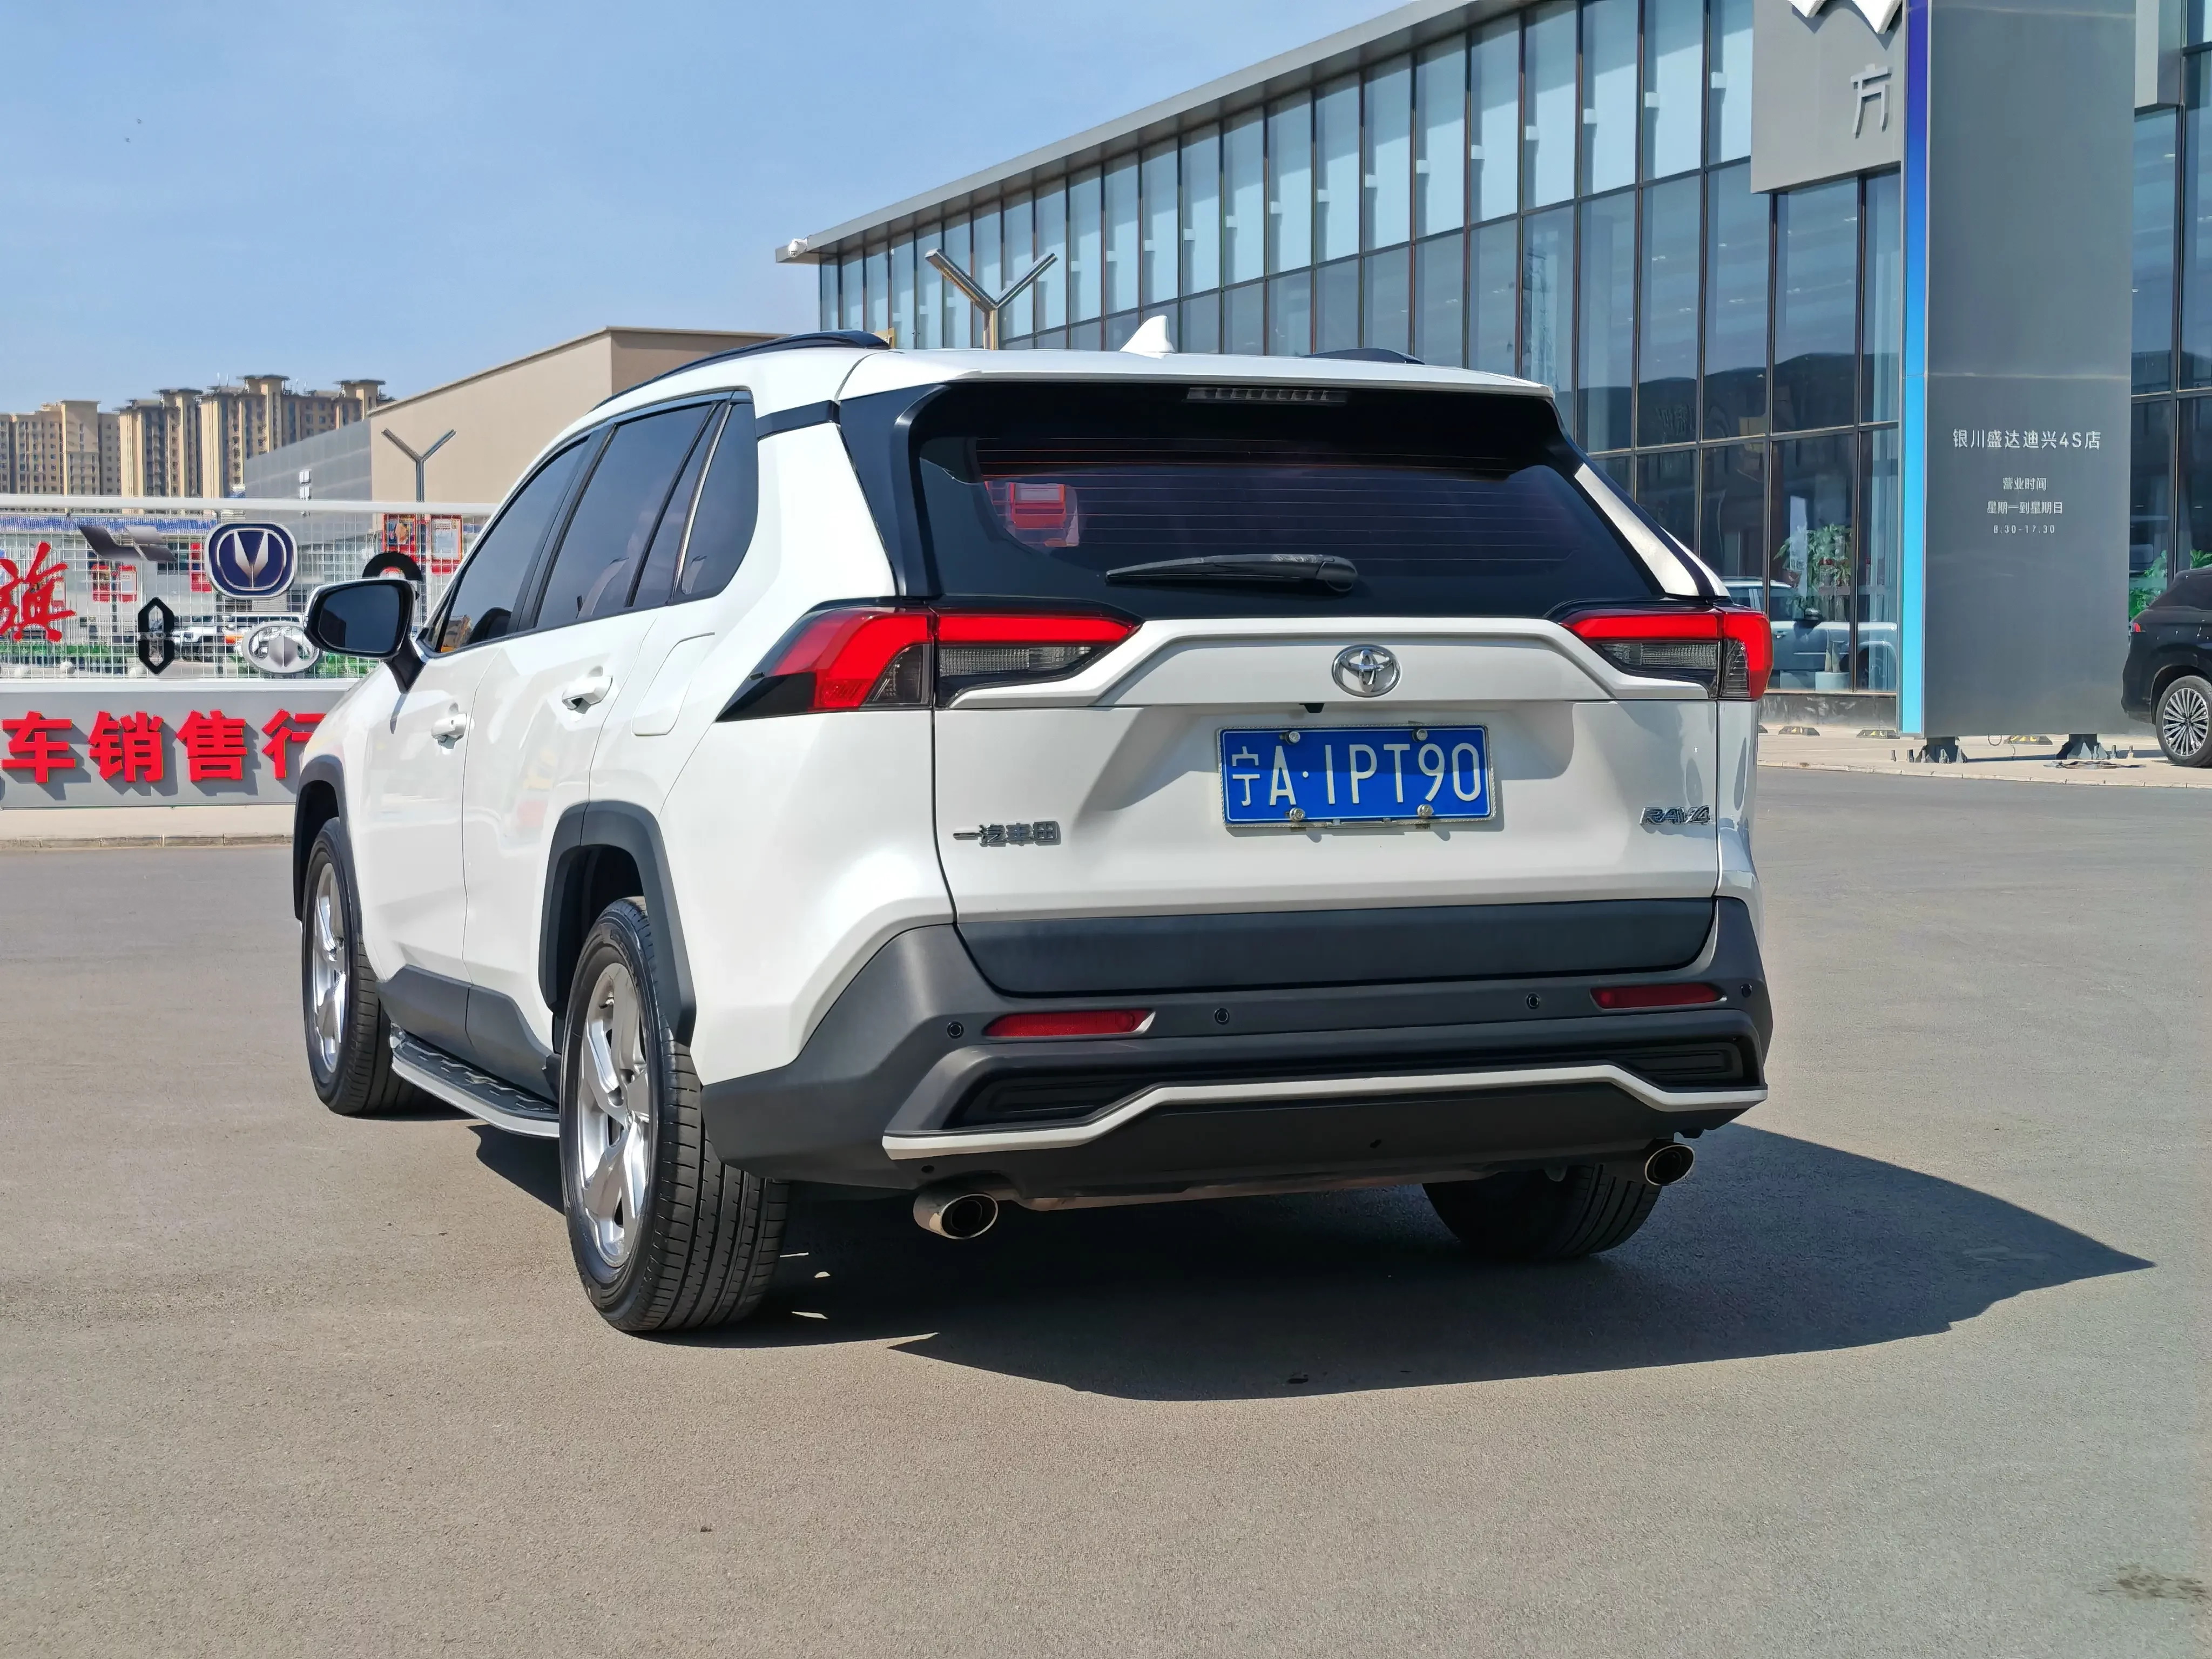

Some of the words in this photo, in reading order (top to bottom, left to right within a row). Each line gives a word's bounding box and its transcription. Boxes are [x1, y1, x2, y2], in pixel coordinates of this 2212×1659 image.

[1952, 429, 2101, 450] 银川盛达迪兴4S店
[2002, 476, 2047, 491] 营业时间
[1987, 501, 2063, 515] 星期一到星期日
[1639, 805, 1711, 825] RAV4
